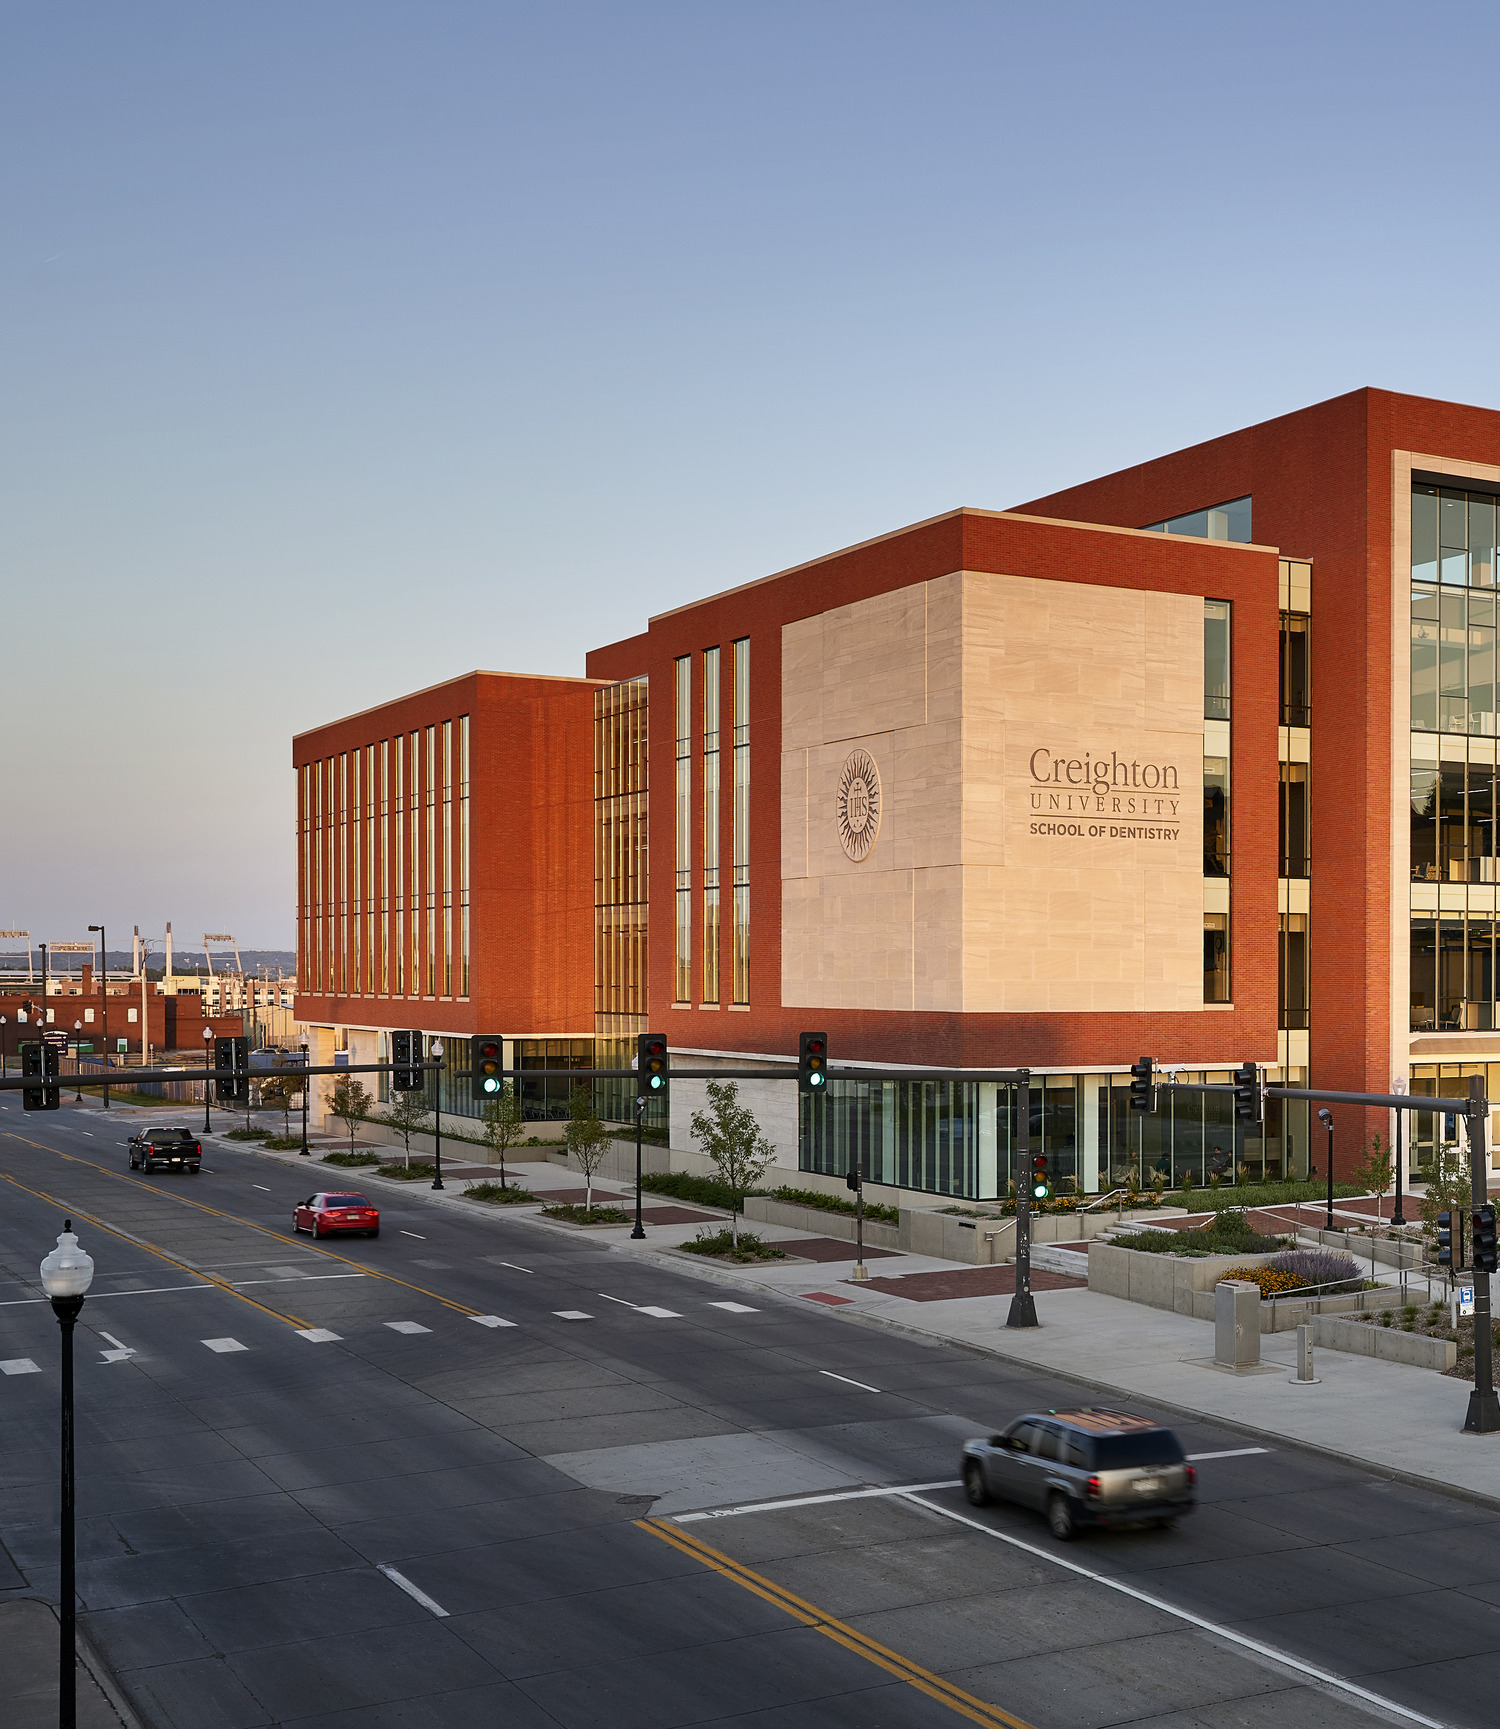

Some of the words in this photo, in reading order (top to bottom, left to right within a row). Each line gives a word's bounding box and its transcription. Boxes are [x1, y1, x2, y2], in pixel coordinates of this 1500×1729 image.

[1030, 748, 1180, 796] Creighton
[1030, 793, 1180, 816] UNIVERSITY
[1030, 823, 1085, 837] SCHOOL
[1088, 825, 1106, 837] OF
[1109, 826, 1180, 841] DENTISTRY
